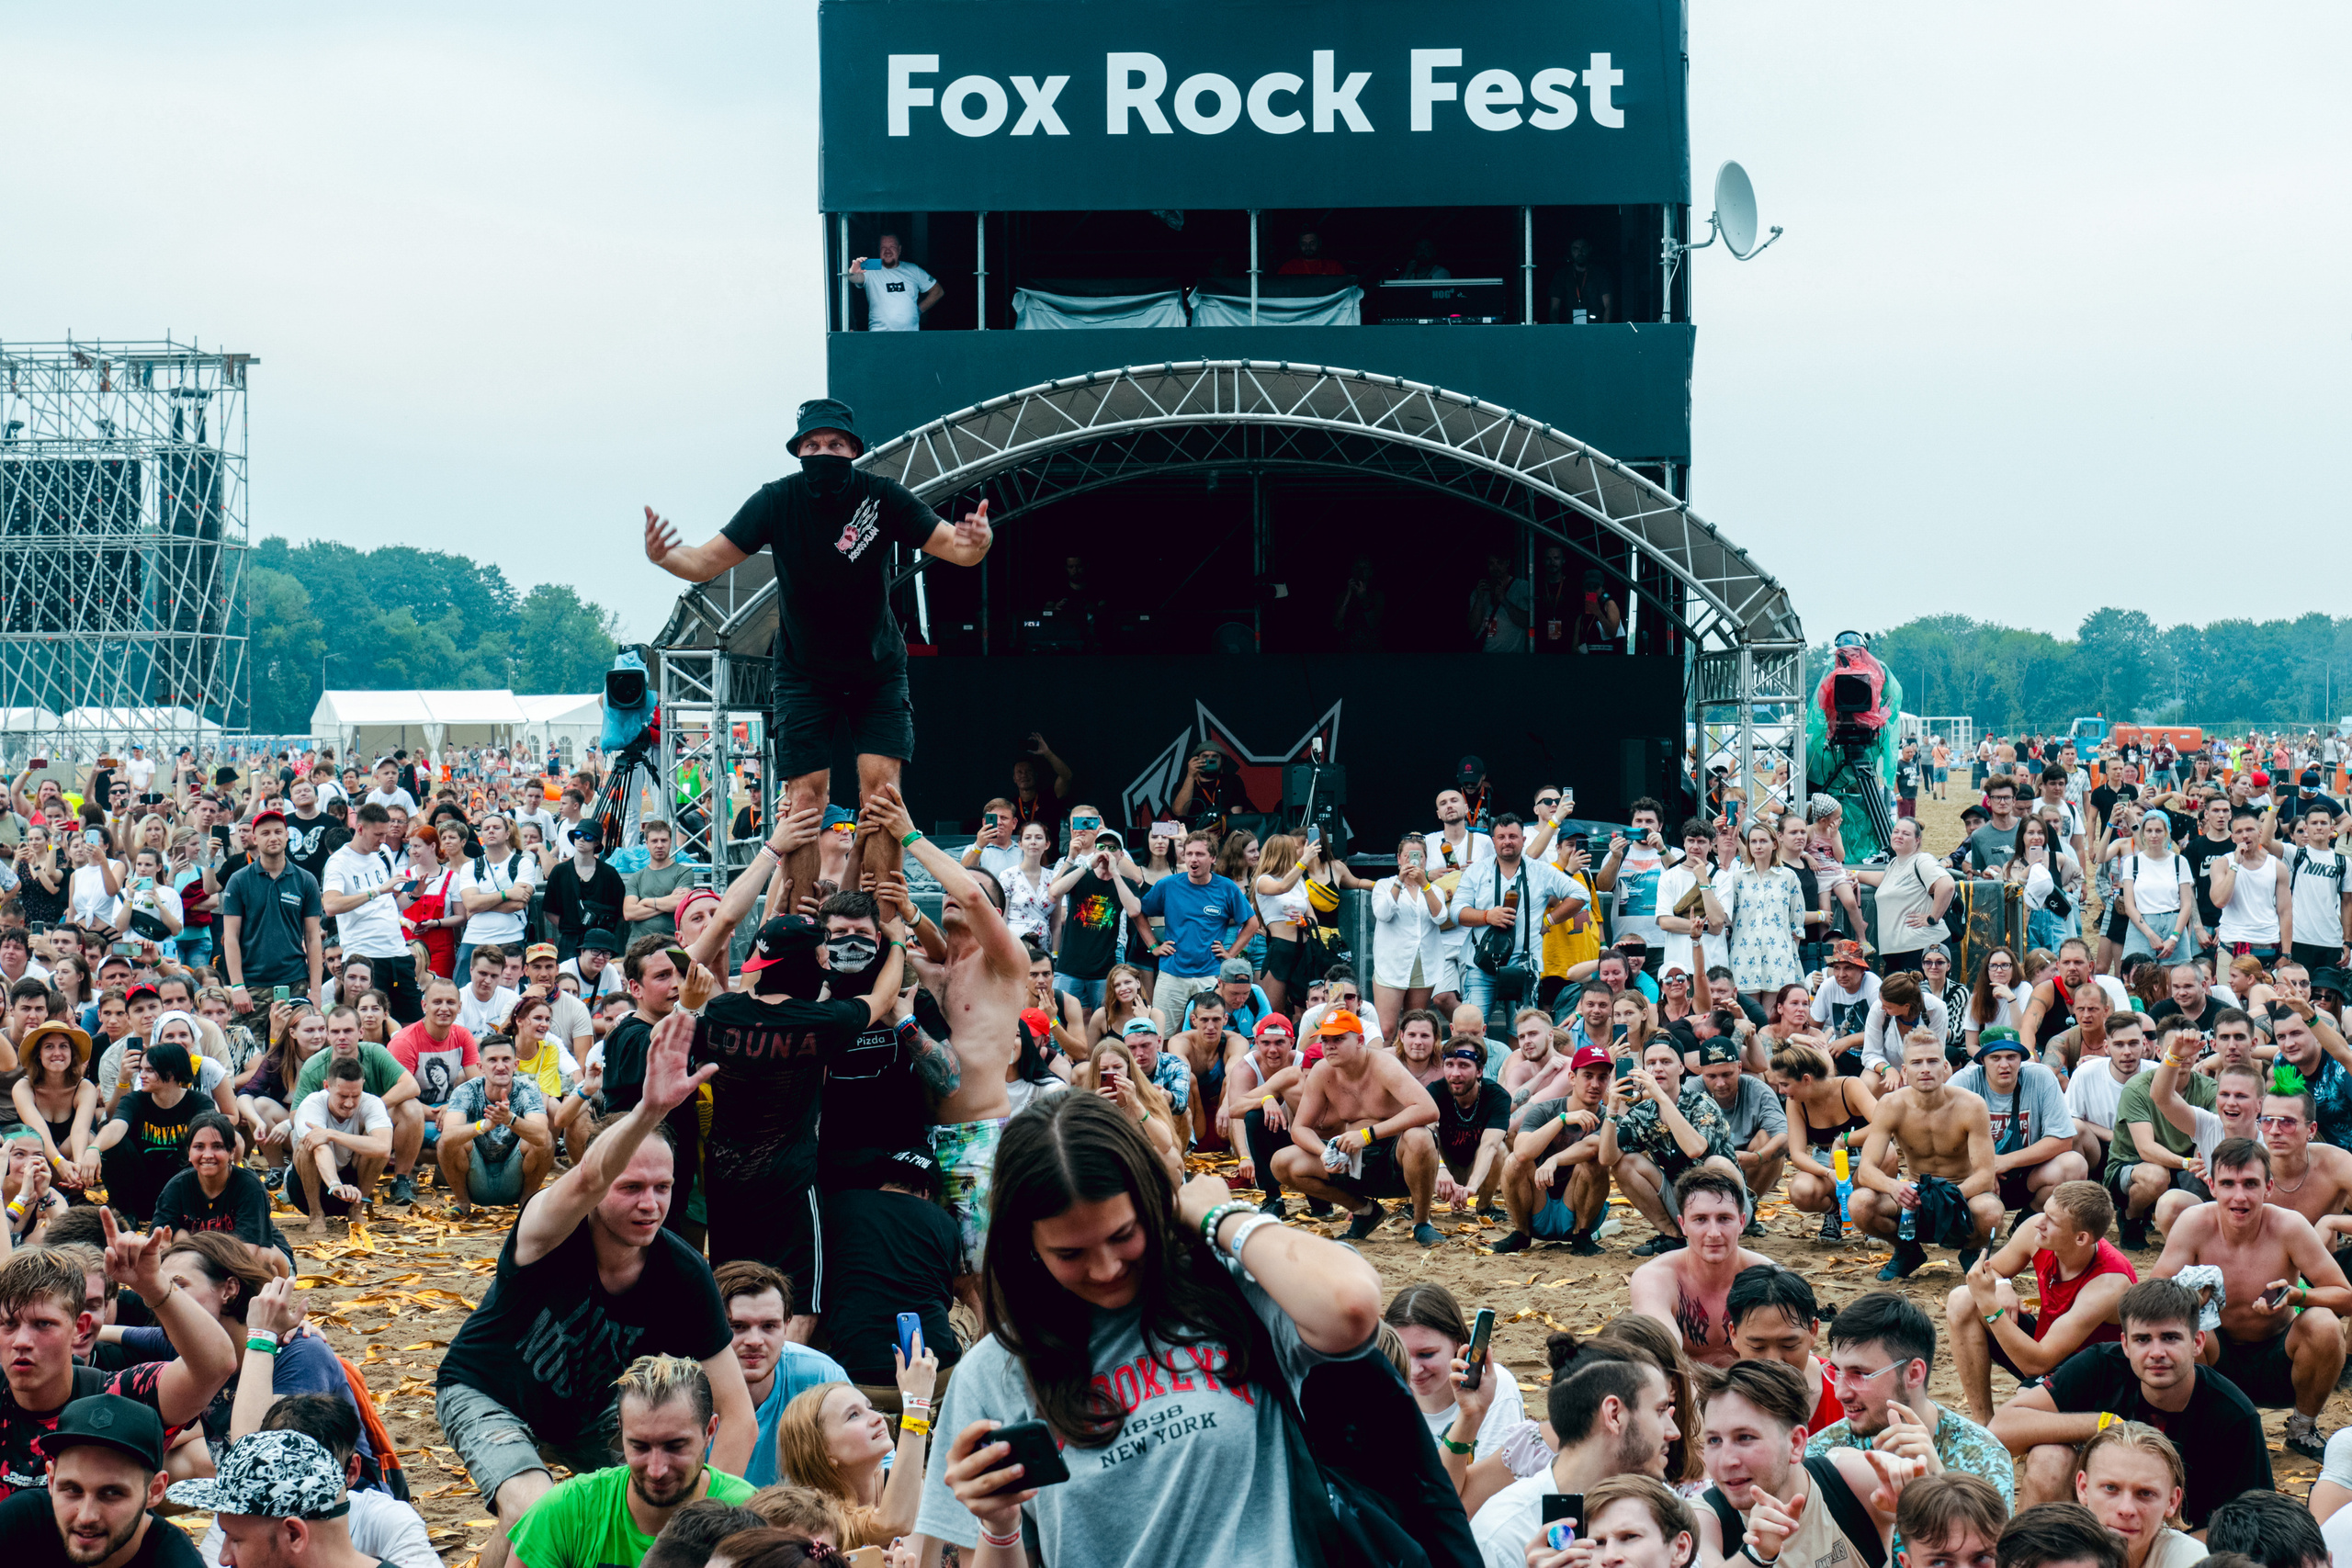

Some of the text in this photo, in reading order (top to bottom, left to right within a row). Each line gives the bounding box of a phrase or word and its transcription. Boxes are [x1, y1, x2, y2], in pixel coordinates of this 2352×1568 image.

[888, 48, 1624, 138] Fox Rock Fest
[2302, 861, 2338, 879] NIKE
[856, 1034, 887, 1047] Pizda
[1123, 1404, 1184, 1438] 1898
[1099, 1411, 1218, 1470] NEW YORK
